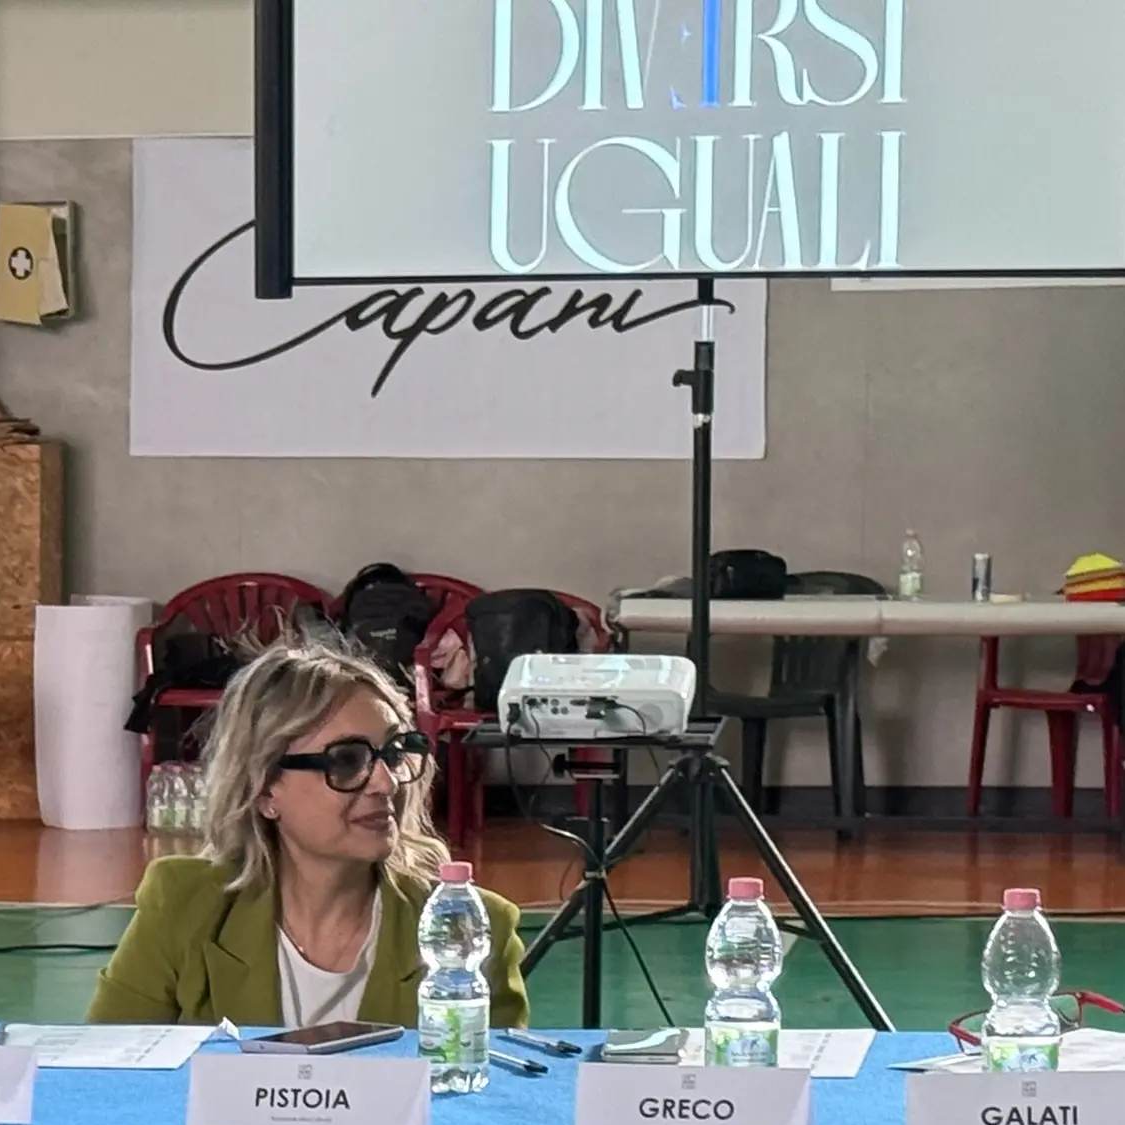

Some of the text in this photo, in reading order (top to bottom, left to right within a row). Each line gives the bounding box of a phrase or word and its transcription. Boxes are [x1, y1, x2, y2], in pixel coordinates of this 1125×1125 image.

[486, 130, 907, 273] UGUALI
[254, 1087, 351, 1110] PISTOIA
[638, 1097, 735, 1121] GRECO
